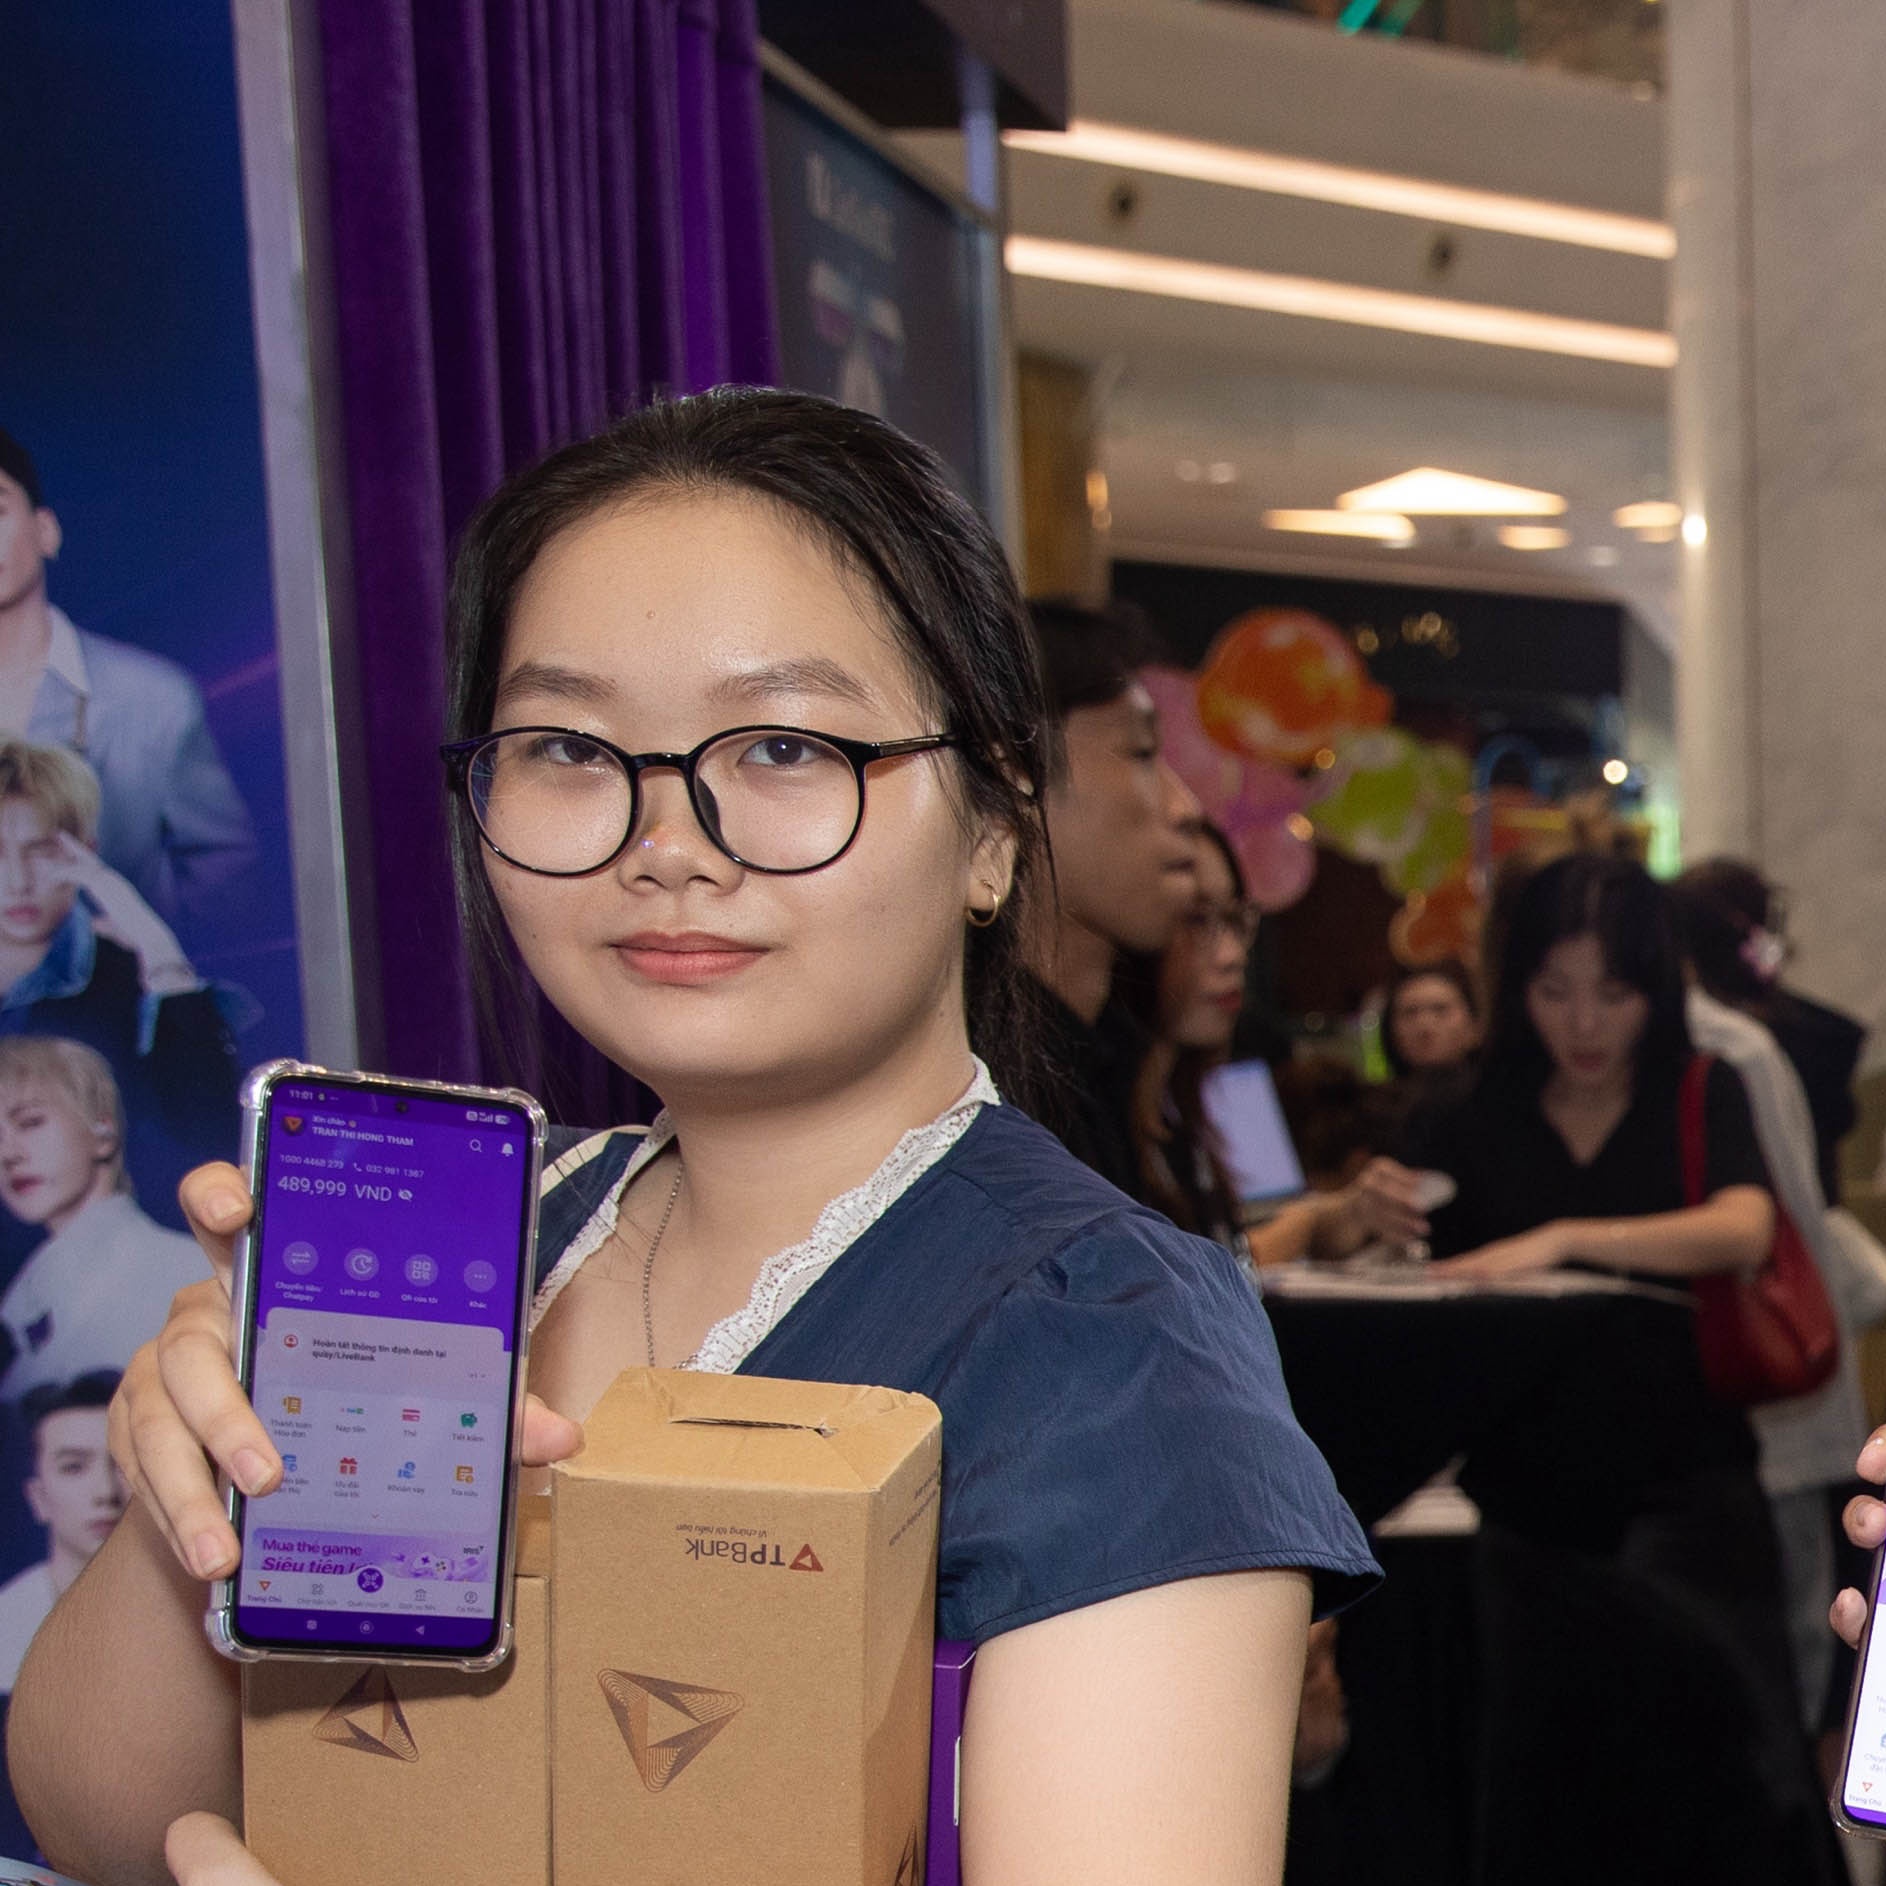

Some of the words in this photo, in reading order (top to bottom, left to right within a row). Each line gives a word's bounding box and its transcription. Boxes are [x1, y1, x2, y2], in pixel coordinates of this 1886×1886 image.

[312, 1127, 338, 1138] TRAN
[340, 1130, 356, 1139] THI
[357, 1131, 384, 1143] HONG
[387, 1135, 414, 1147] THAM
[277, 1175, 347, 1196] 489,999
[354, 1183, 393, 1202] VND
[262, 1538, 294, 1552] Mua
[321, 1544, 363, 1557] game
[686, 1538, 785, 1566] TPBank
[261, 1557, 305, 1574] Siêu
